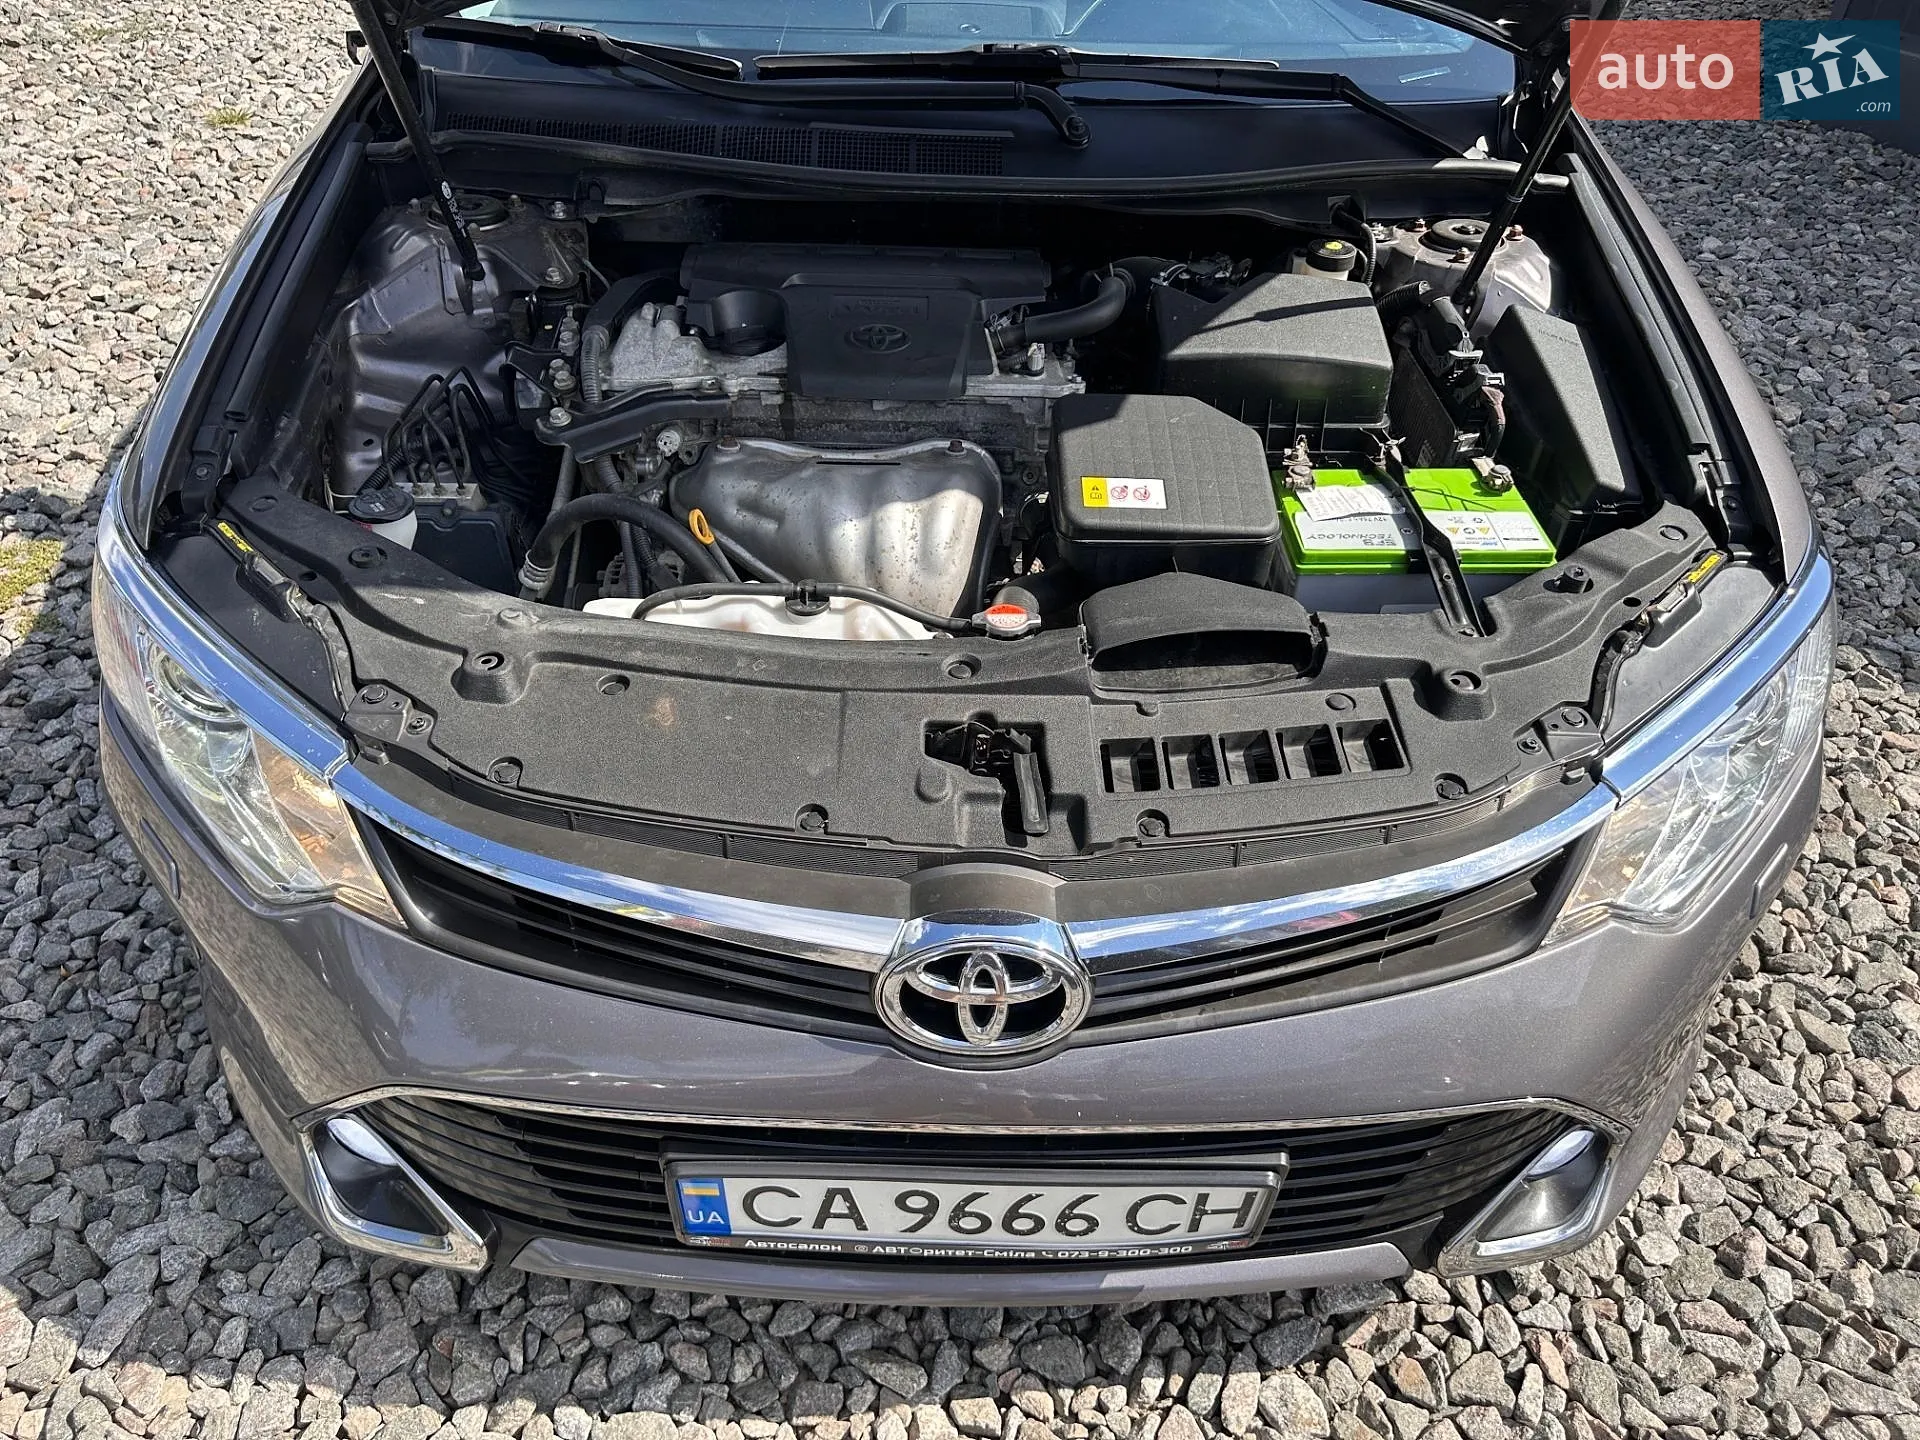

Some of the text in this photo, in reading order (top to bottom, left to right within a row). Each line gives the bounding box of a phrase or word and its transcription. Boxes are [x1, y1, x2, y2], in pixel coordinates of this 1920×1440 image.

[688, 1210, 725, 1225] UA
[742, 1185, 1258, 1237] CA 9666 CH
[745, 1239, 842, 1252] Автосалон
[1057, 1245, 1193, 1258] 073-9-300-300
